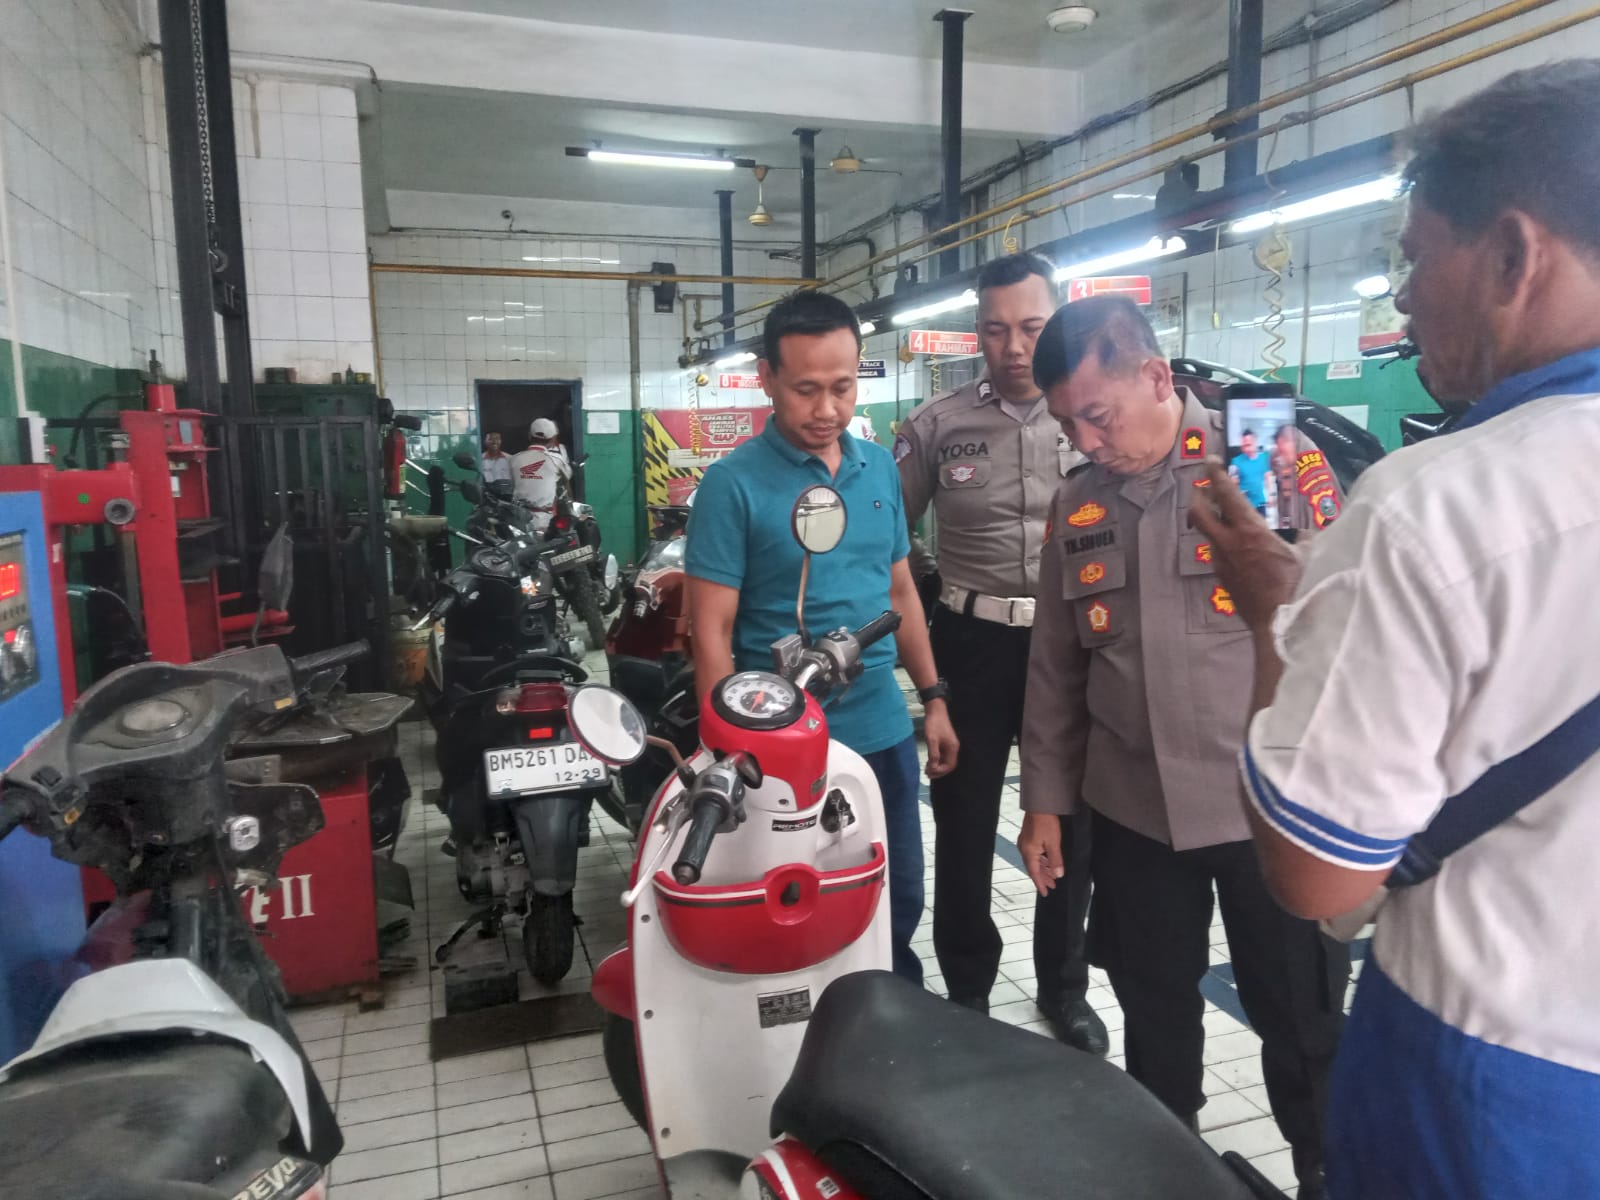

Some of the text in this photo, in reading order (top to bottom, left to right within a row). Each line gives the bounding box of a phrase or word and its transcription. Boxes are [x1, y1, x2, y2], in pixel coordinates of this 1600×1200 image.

[914, 333, 924, 352] 4
[934, 344, 974, 353] RAHMAT
[940, 442, 989, 459] YOGA
[564, 746, 595, 764] DA
